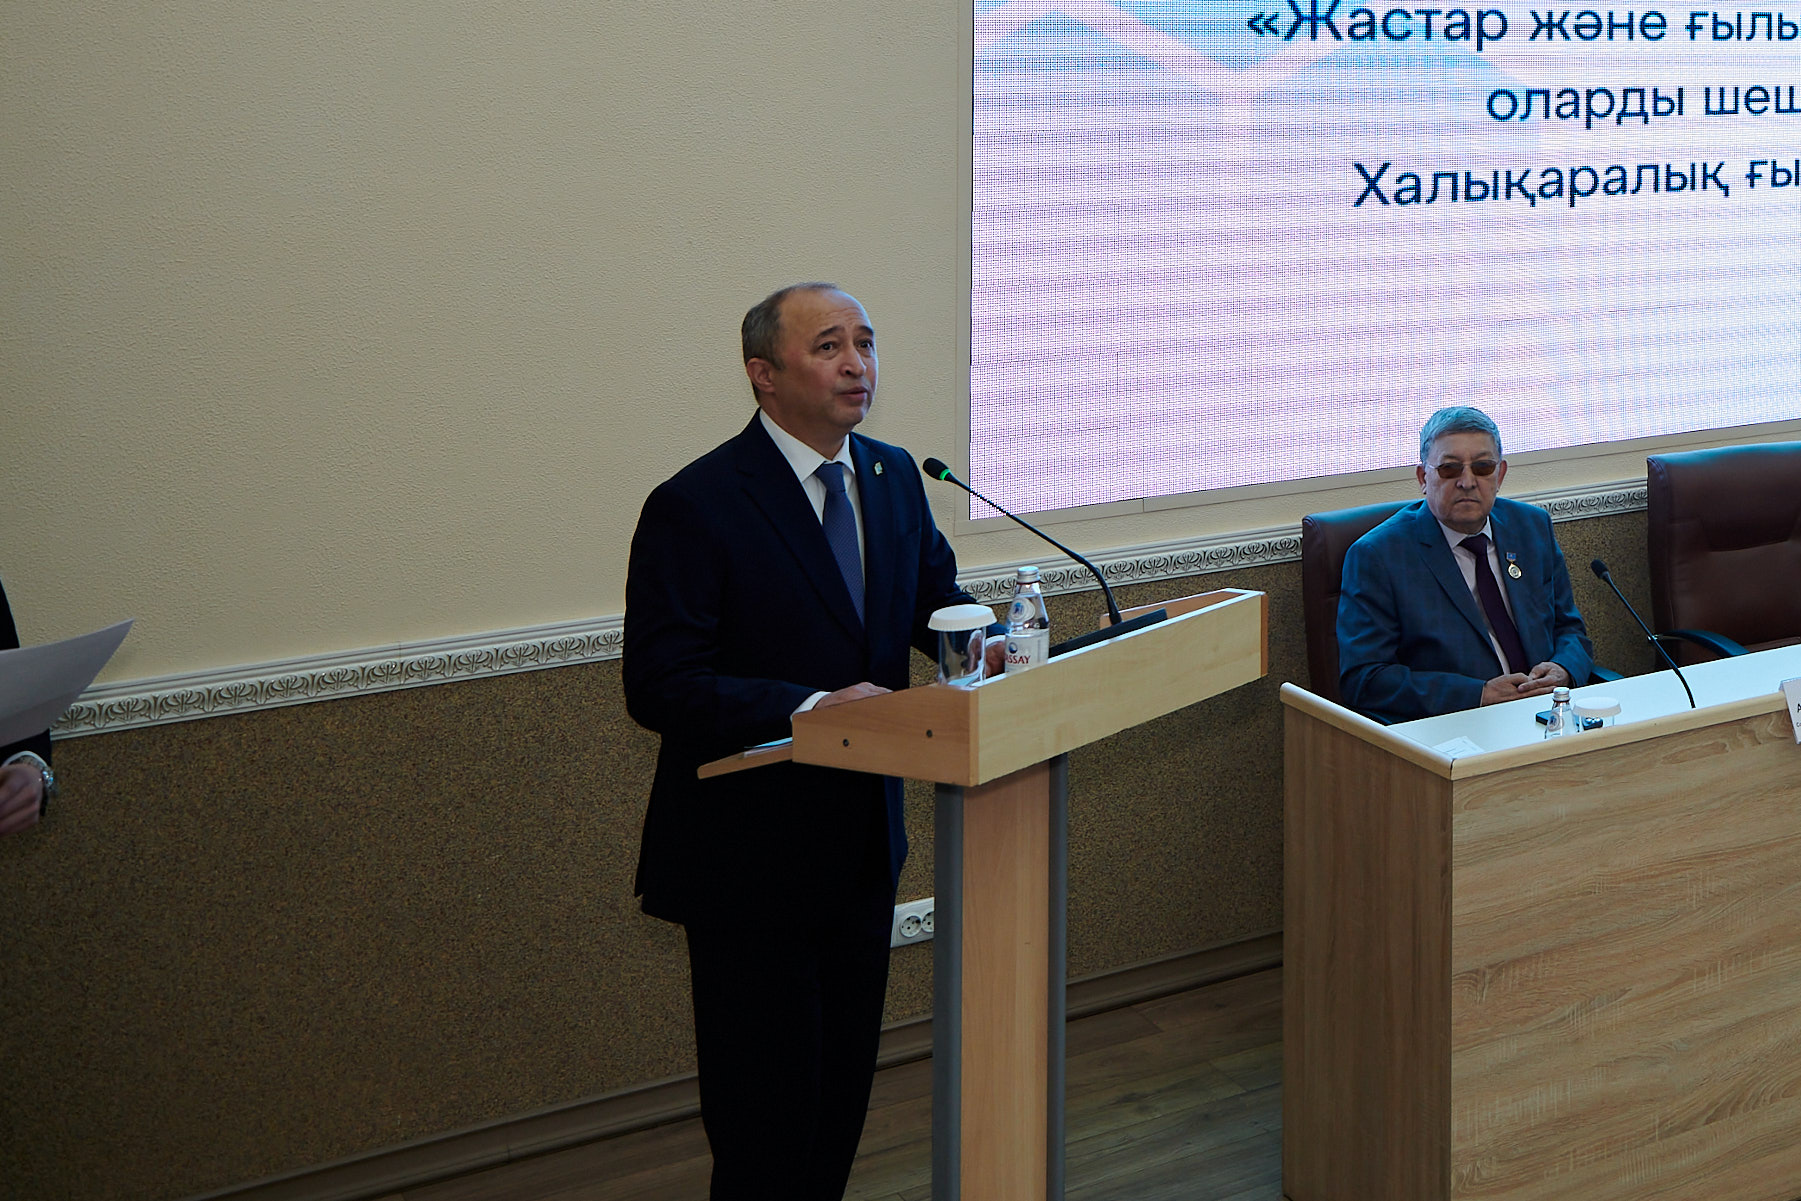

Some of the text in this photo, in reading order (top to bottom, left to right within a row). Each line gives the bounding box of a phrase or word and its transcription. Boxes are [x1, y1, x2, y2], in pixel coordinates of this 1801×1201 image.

[1529, 8, 1668, 43] және
[1486, 85, 1685, 129] оларды
[1353, 159, 1730, 207] Халықаралық
